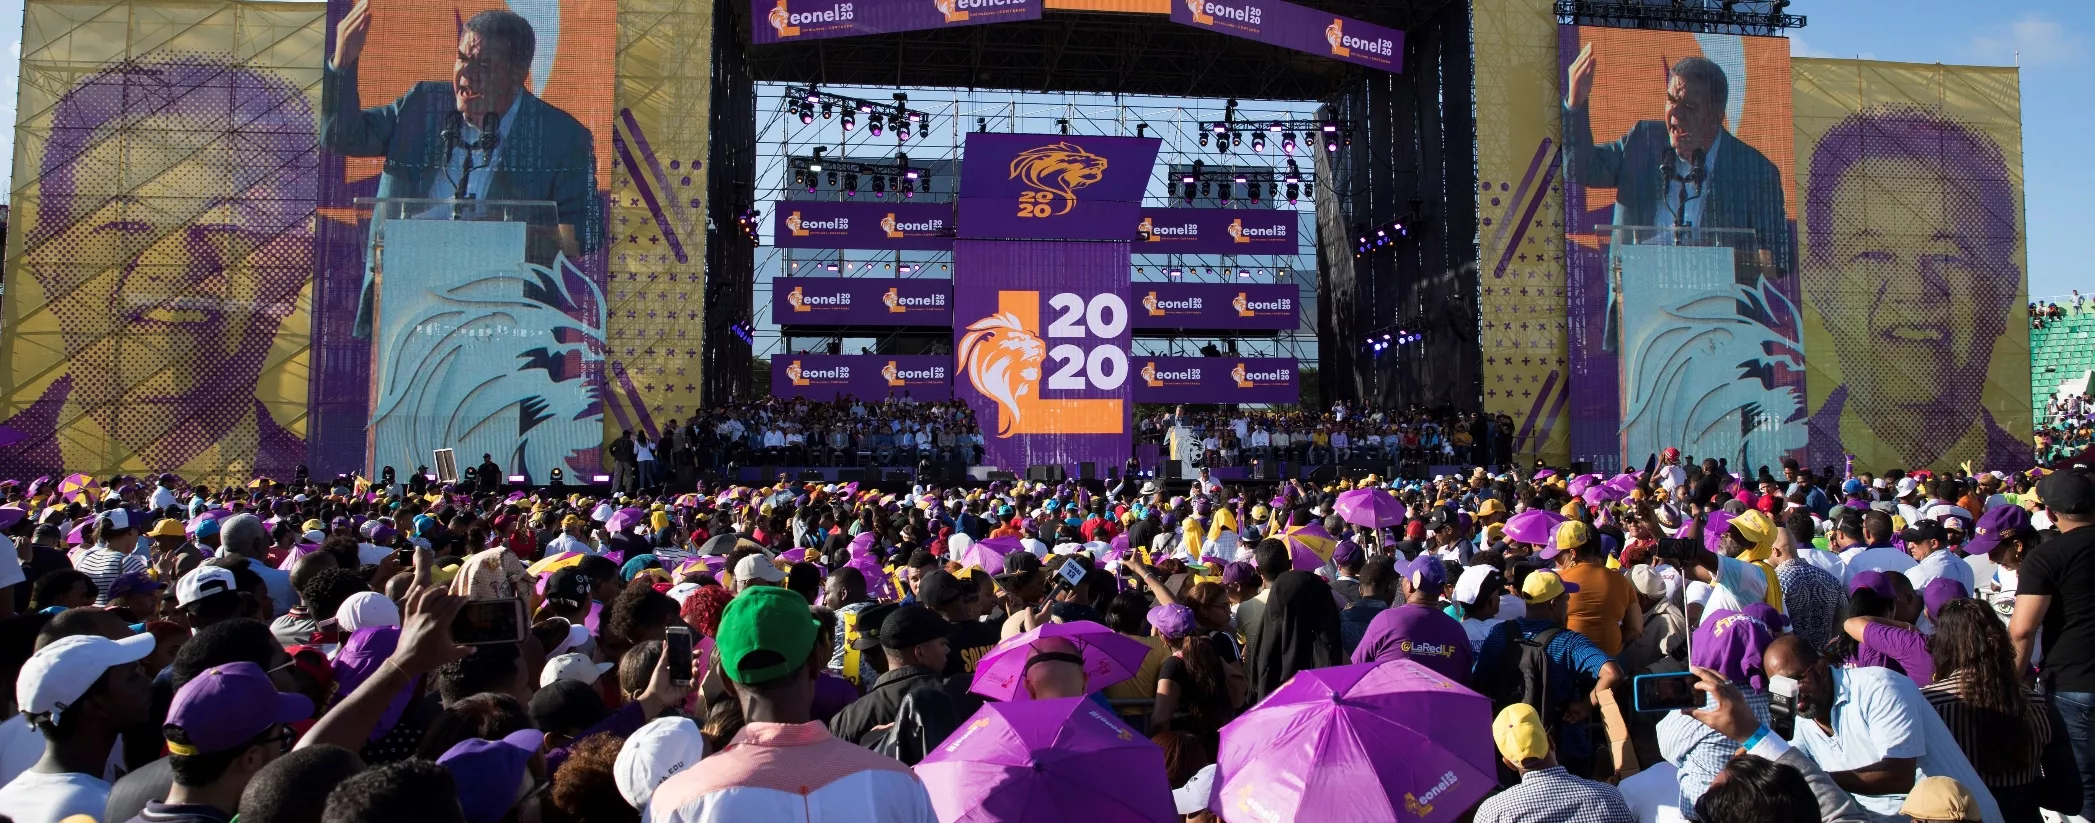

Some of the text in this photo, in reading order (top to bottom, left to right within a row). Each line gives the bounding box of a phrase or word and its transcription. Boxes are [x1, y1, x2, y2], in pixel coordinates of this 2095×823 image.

[840, 3, 853, 11] 20
[1250, 7, 1262, 16] 20
[840, 12, 854, 20] 20
[1249, 15, 1261, 24] 20
[1382, 39, 1393, 48] 20
[1381, 48, 1392, 57] 20
[1018, 191, 1053, 203] 20
[1017, 203, 1052, 218] 20
[1048, 292, 1128, 339] 20
[1048, 344, 1129, 390] 20
[1066, 568, 1077, 579] 13
[1067, 561, 1082, 576] CANAL
[1401, 641, 1456, 656] @LaRedLF
